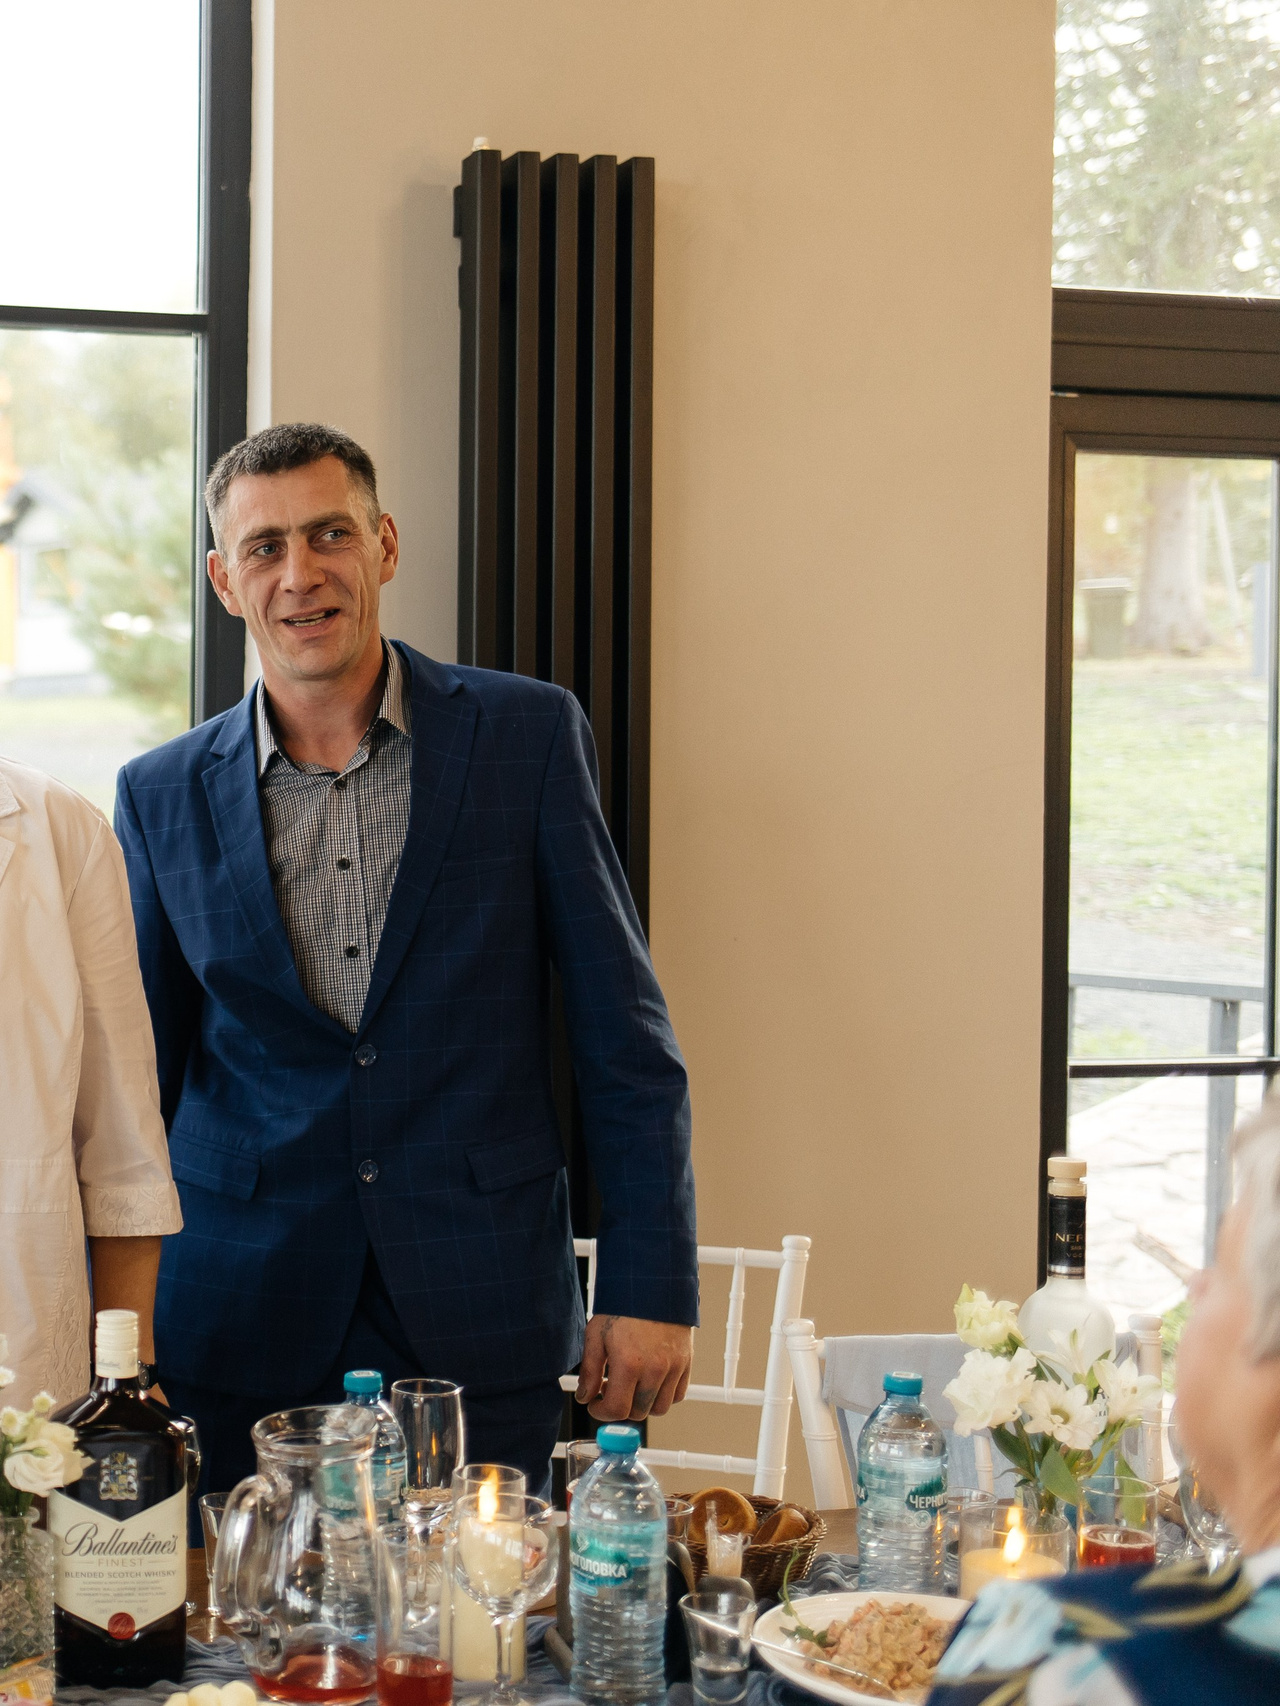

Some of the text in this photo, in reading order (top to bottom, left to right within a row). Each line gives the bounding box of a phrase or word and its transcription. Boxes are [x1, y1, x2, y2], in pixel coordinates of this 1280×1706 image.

[62, 1521, 178, 1556] Ballantine's
[98, 1558, 144, 1567] FINEST
[144, 1570, 176, 1578] WHISKY
